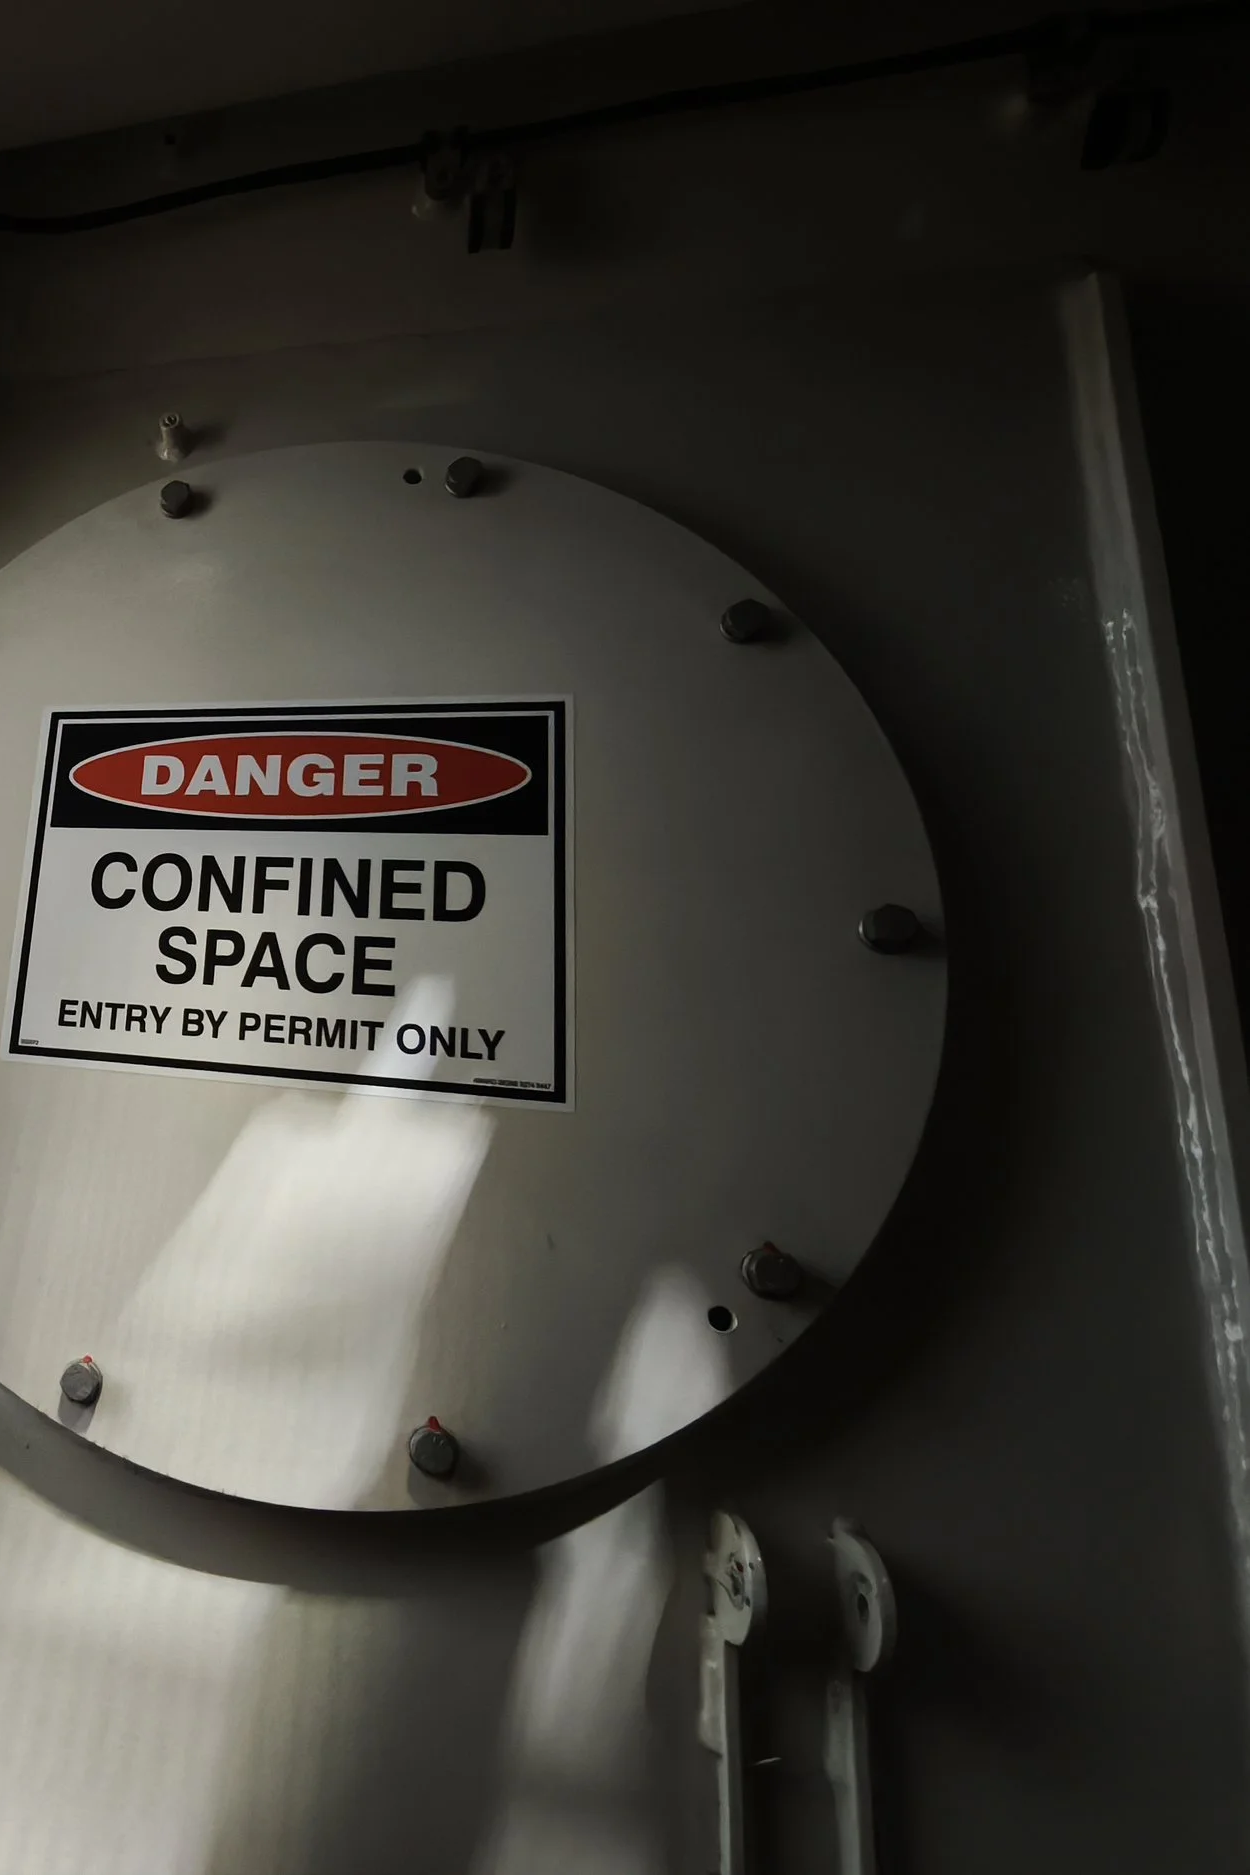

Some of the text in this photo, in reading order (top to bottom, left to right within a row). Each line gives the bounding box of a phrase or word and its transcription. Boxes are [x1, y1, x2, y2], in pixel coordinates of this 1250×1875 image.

[140, 754, 439, 798] DANGER
[90, 852, 486, 922] CONFINED
[155, 926, 397, 997] SPACE
[57, 999, 506, 1061] ENTRY BY PERMIT ONLY
